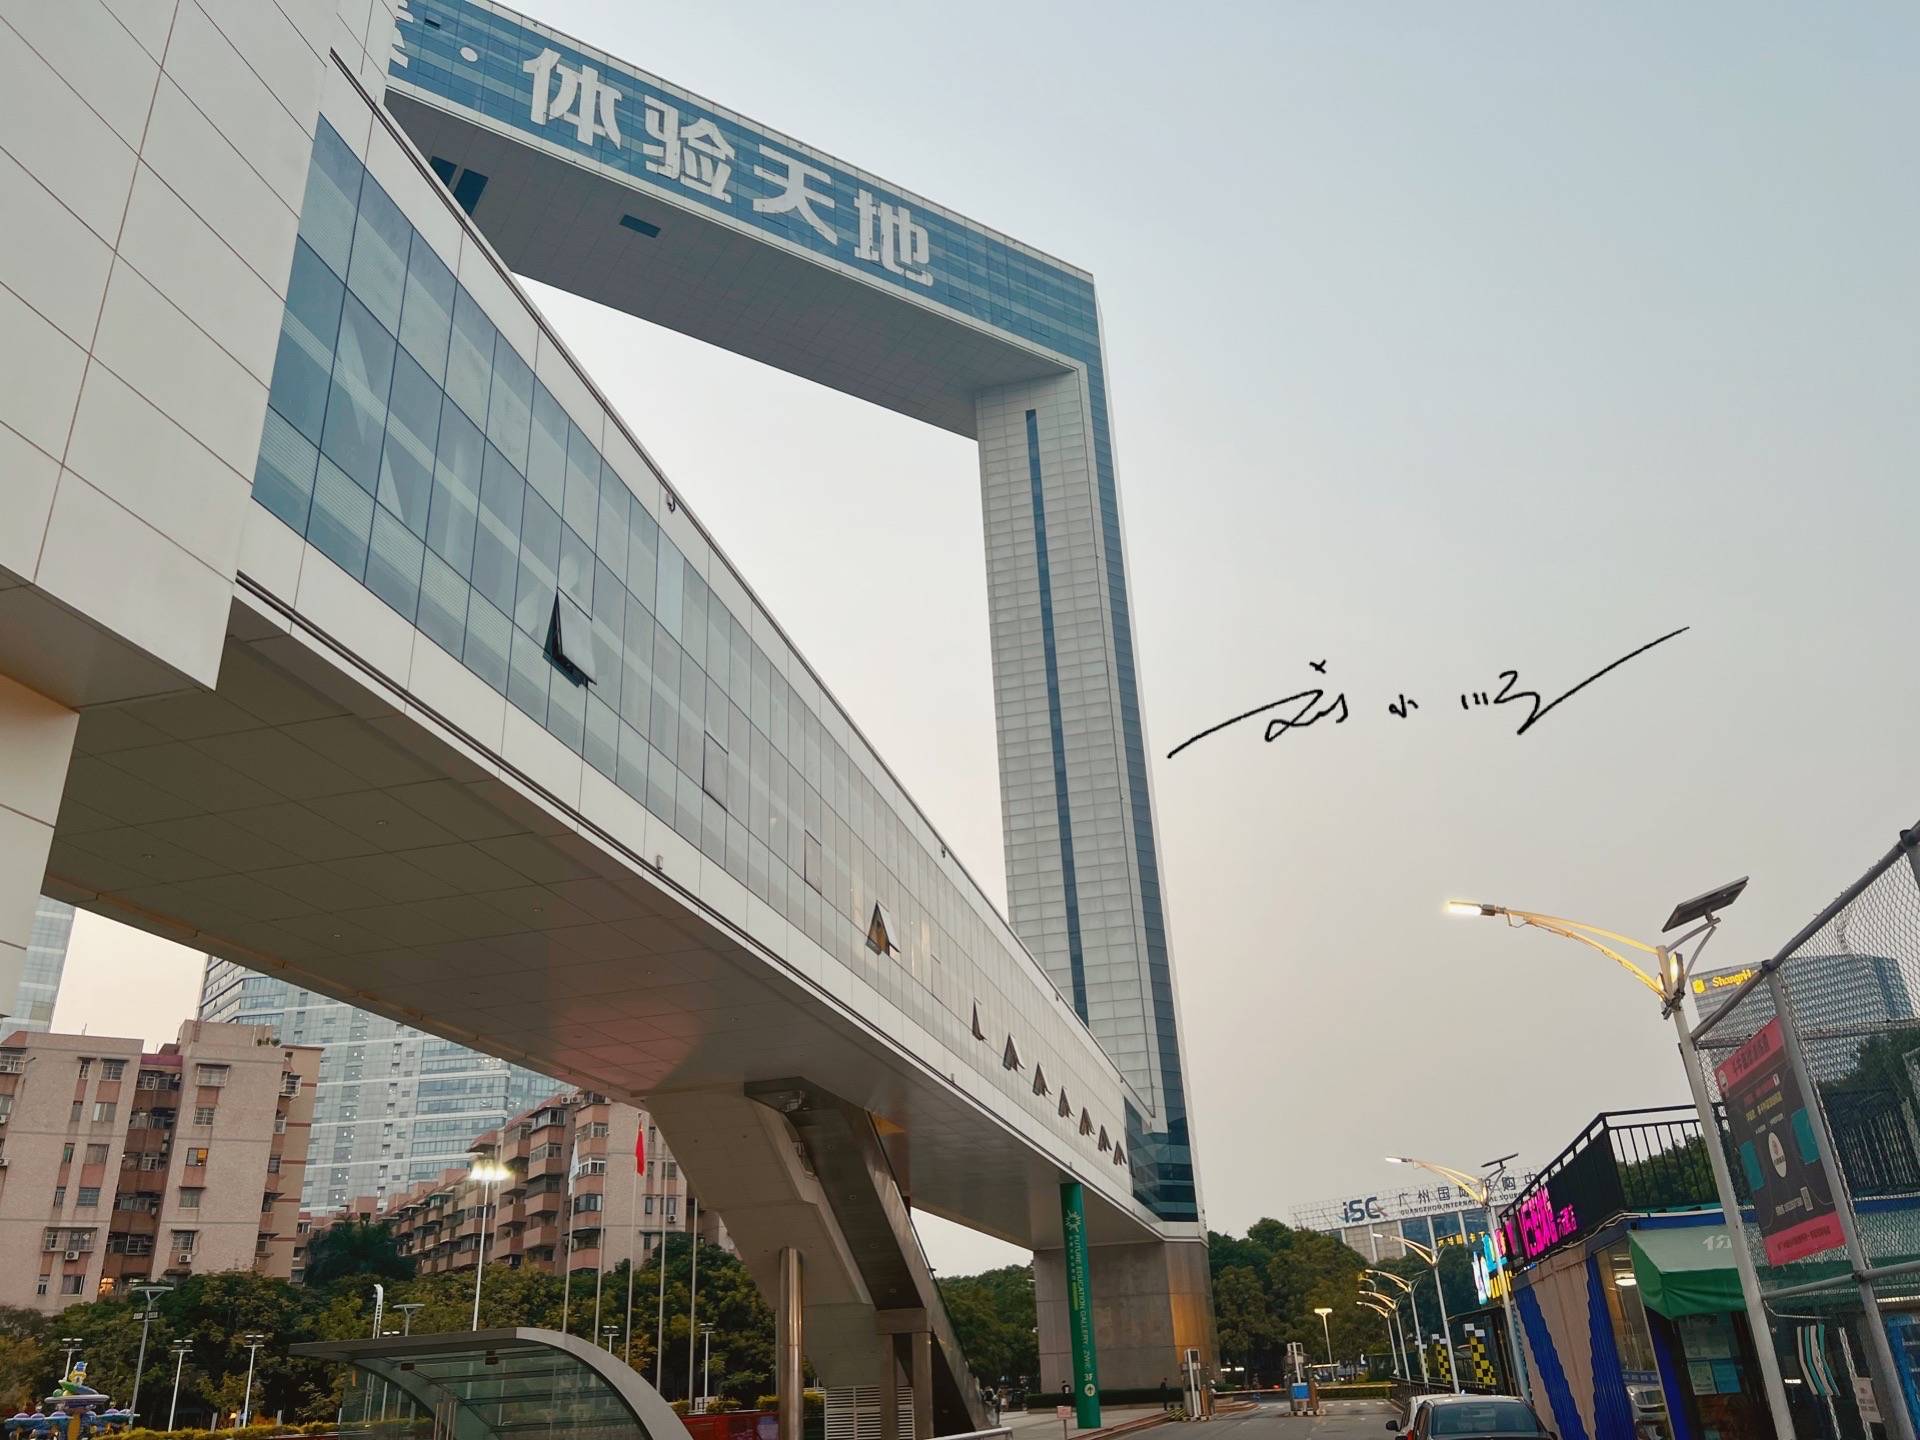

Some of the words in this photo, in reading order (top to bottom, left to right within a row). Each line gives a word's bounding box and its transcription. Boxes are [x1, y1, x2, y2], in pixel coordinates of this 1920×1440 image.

[522, 46, 934, 287] 体验天地
[1075, 1266, 1086, 1309] EDUCATION
